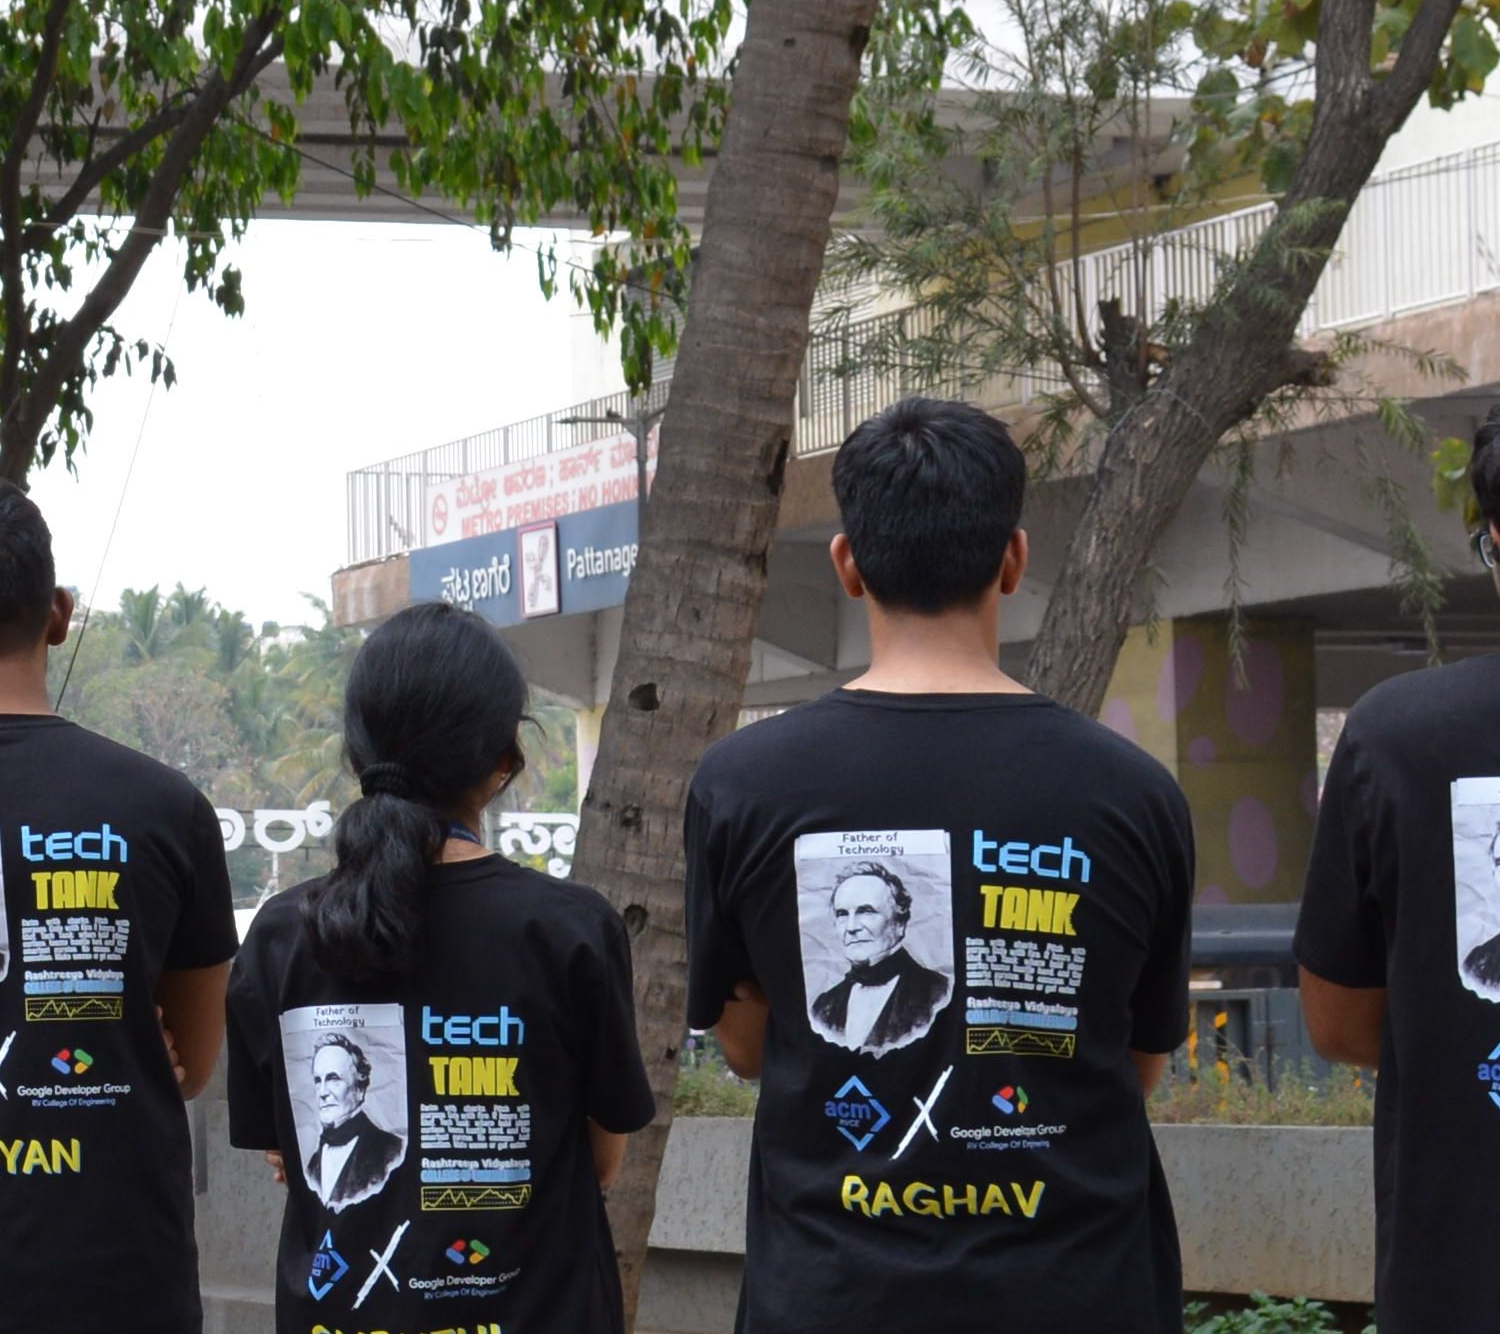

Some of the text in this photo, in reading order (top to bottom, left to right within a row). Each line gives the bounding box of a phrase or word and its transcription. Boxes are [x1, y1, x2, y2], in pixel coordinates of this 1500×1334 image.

[462, 508, 503, 539] METRO
[507, 491, 570, 529] PREMISES
[21, 824, 128, 863] tech
[838, 845, 904, 856] Technology
[842, 832, 898, 843] Father of
[972, 829, 1091, 883] tech
[31, 870, 120, 910] TANK
[980, 885, 1080, 937] TANK
[314, 1018, 365, 1028] Technology
[316, 1005, 360, 1017] Father of
[422, 1005, 524, 1045] tech
[17, 1083, 131, 1097] Google Developer Group
[429, 1056, 520, 1096] TANK
[825, 1101, 872, 1120] acm
[950, 1126, 992, 1139] Google
[841, 1174, 1046, 1219] RAGHAV
[409, 1274, 498, 1290] Google Developer
